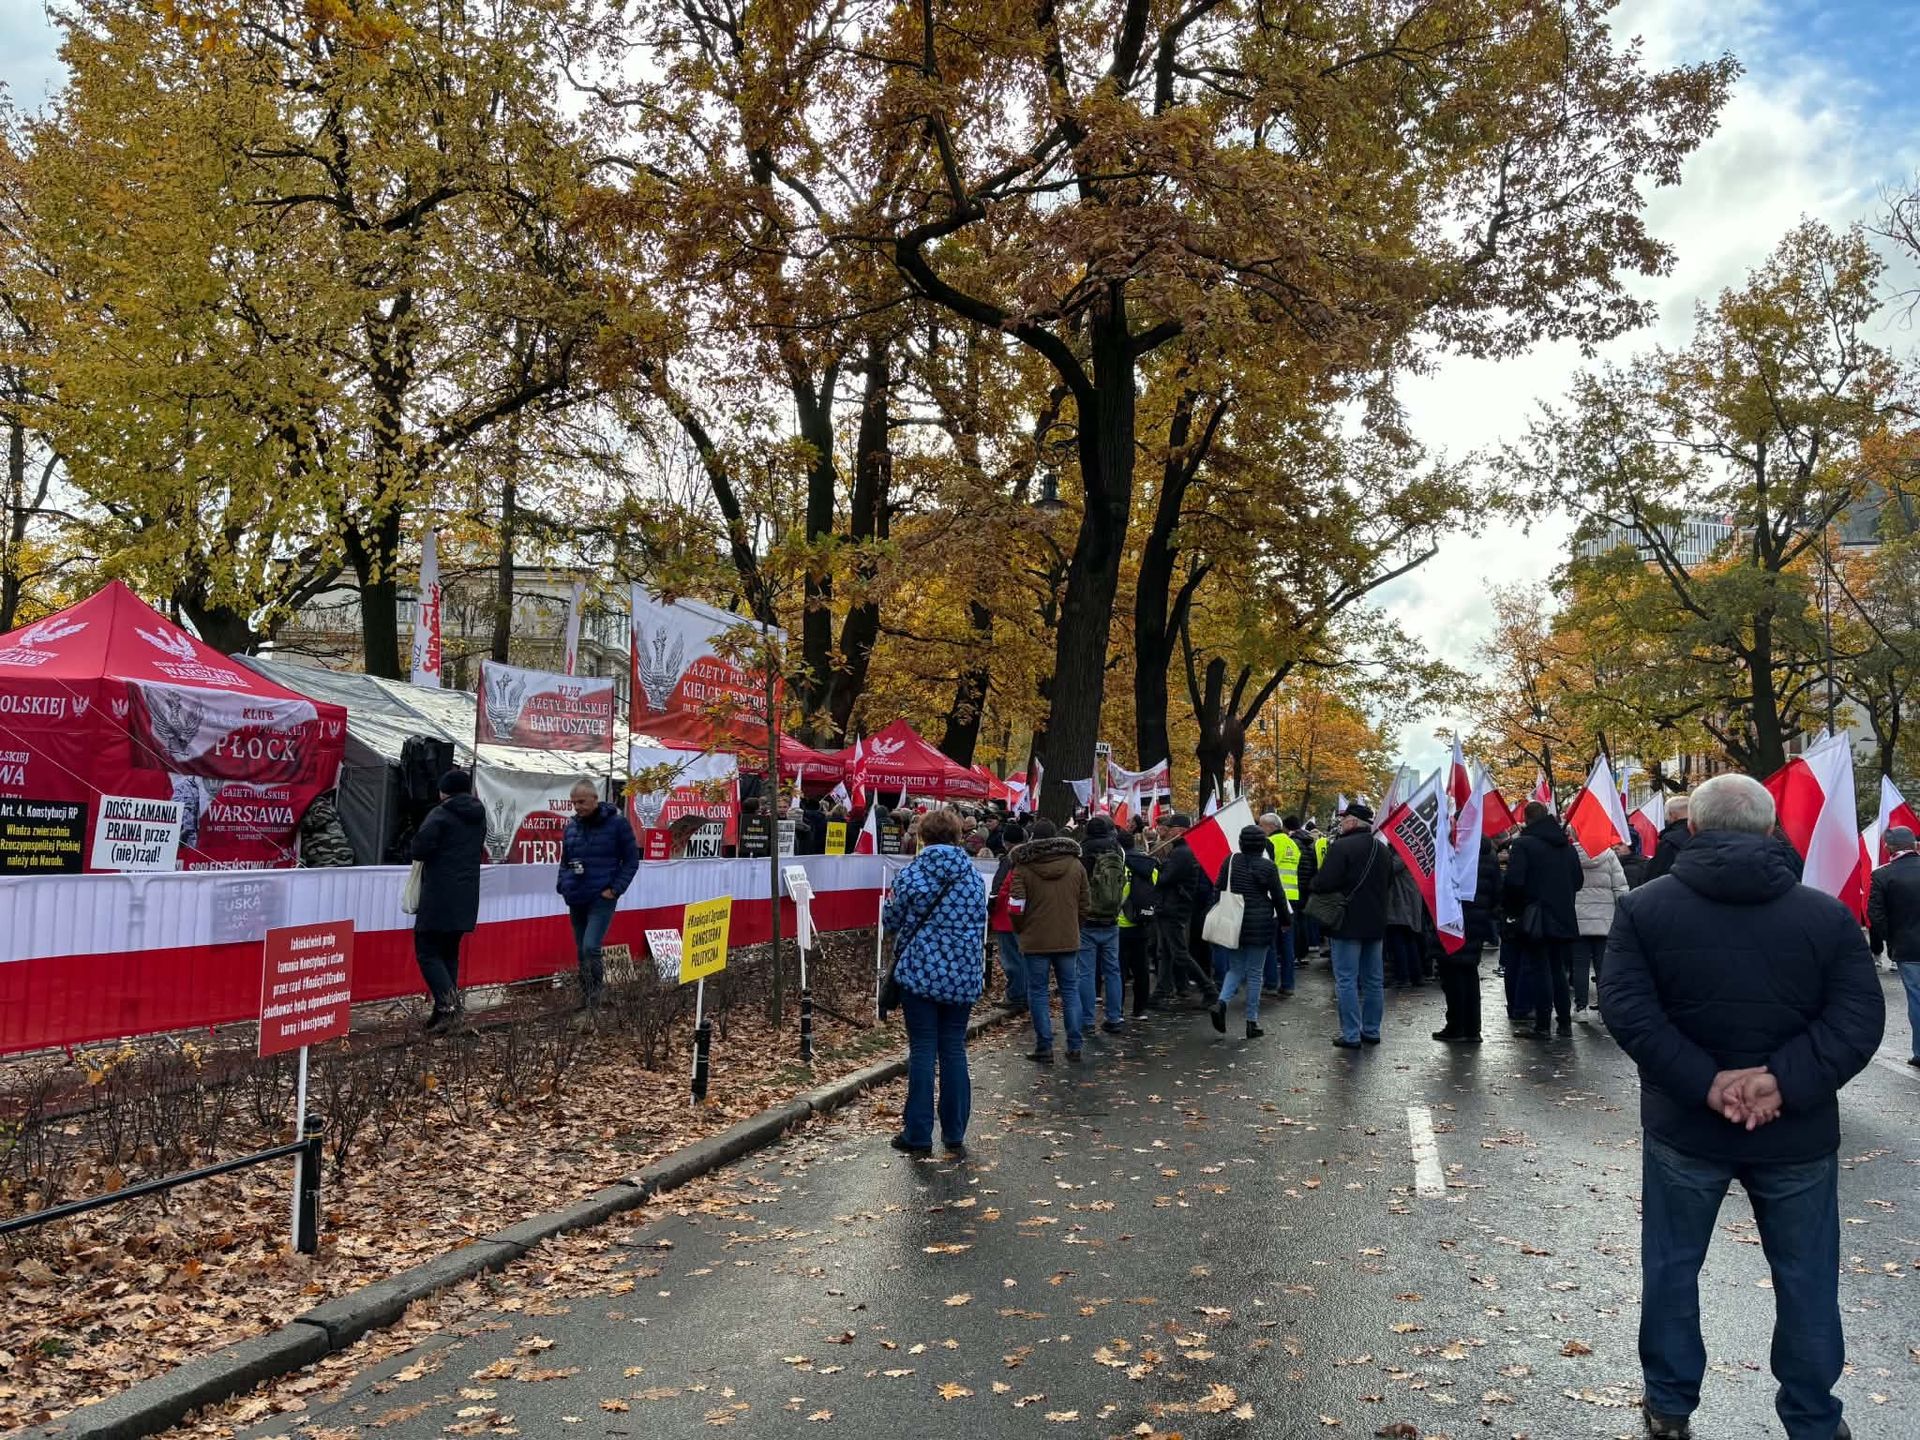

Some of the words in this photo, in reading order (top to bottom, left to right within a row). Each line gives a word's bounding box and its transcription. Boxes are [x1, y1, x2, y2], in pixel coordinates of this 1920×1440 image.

[413, 644, 421, 672] NSZZ
[242, 708, 274, 720] KLUB
[530, 714, 606, 735] BARTOSZYCE
[215, 734, 296, 761] PŁOCK
[885, 775, 926, 787] POLSKIEJ
[0, 803, 15, 818] Art.
[17, 804, 25, 817] 4.
[26, 804, 67, 821] Konstytucji
[68, 806, 79, 820] RP
[104, 799, 132, 819] DOŚĆ
[134, 803, 177, 823] ŁAMANIA
[549, 799, 573, 811] KLUB
[208, 805, 295, 824] WARSZAWA
[522, 817, 557, 830] GAZETY
[6, 824, 31, 837] Władza
[32, 824, 70, 838] zwierzchnia
[105, 822, 142, 842] PRAWA
[144, 828, 171, 845] przez
[0, 838, 55, 854] Rzeczypospolitej
[56, 839, 81, 854] Polskiej
[111, 843, 161, 866] (nie)rząd!
[1394, 824, 1432, 878] OJCZYZNA
[7, 854, 28, 868] należy
[29, 855, 39, 866] do
